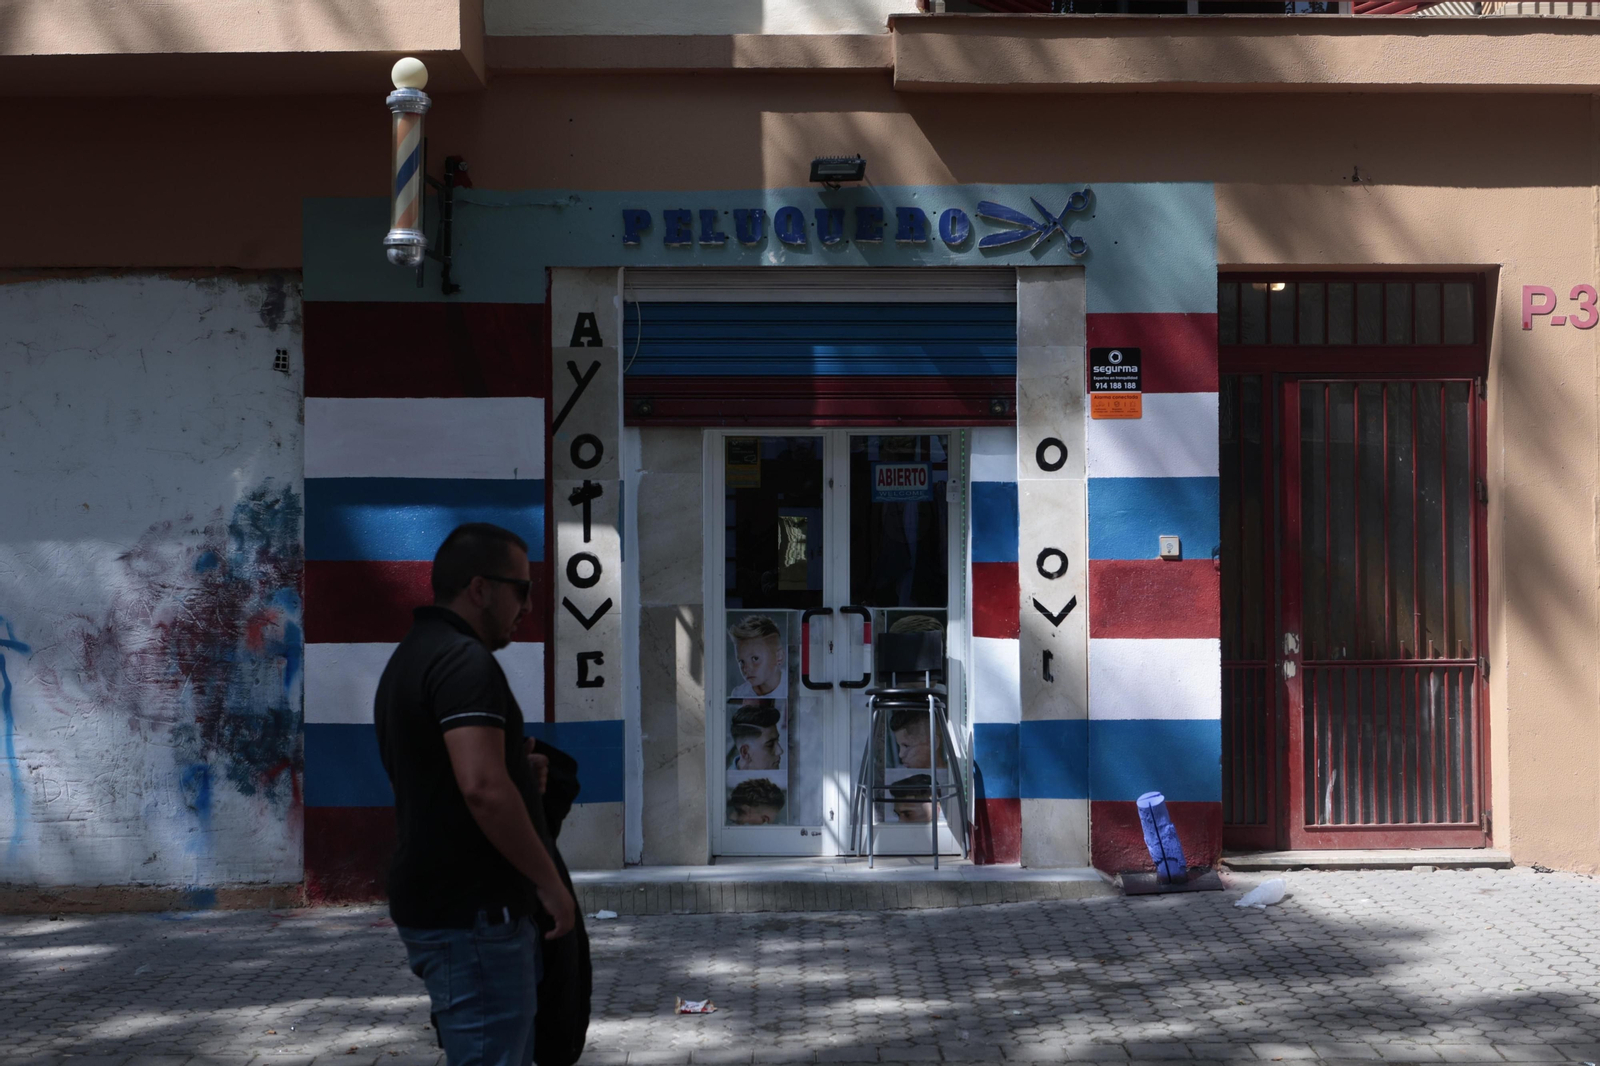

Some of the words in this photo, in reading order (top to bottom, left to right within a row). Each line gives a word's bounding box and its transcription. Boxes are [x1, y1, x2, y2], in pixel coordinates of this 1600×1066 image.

[622, 206, 971, 245] PELUQUERO
[1522, 284, 1599, 330] P-3
[1093, 365, 1138, 375] segurma
[877, 467, 926, 486] ABIERTO
